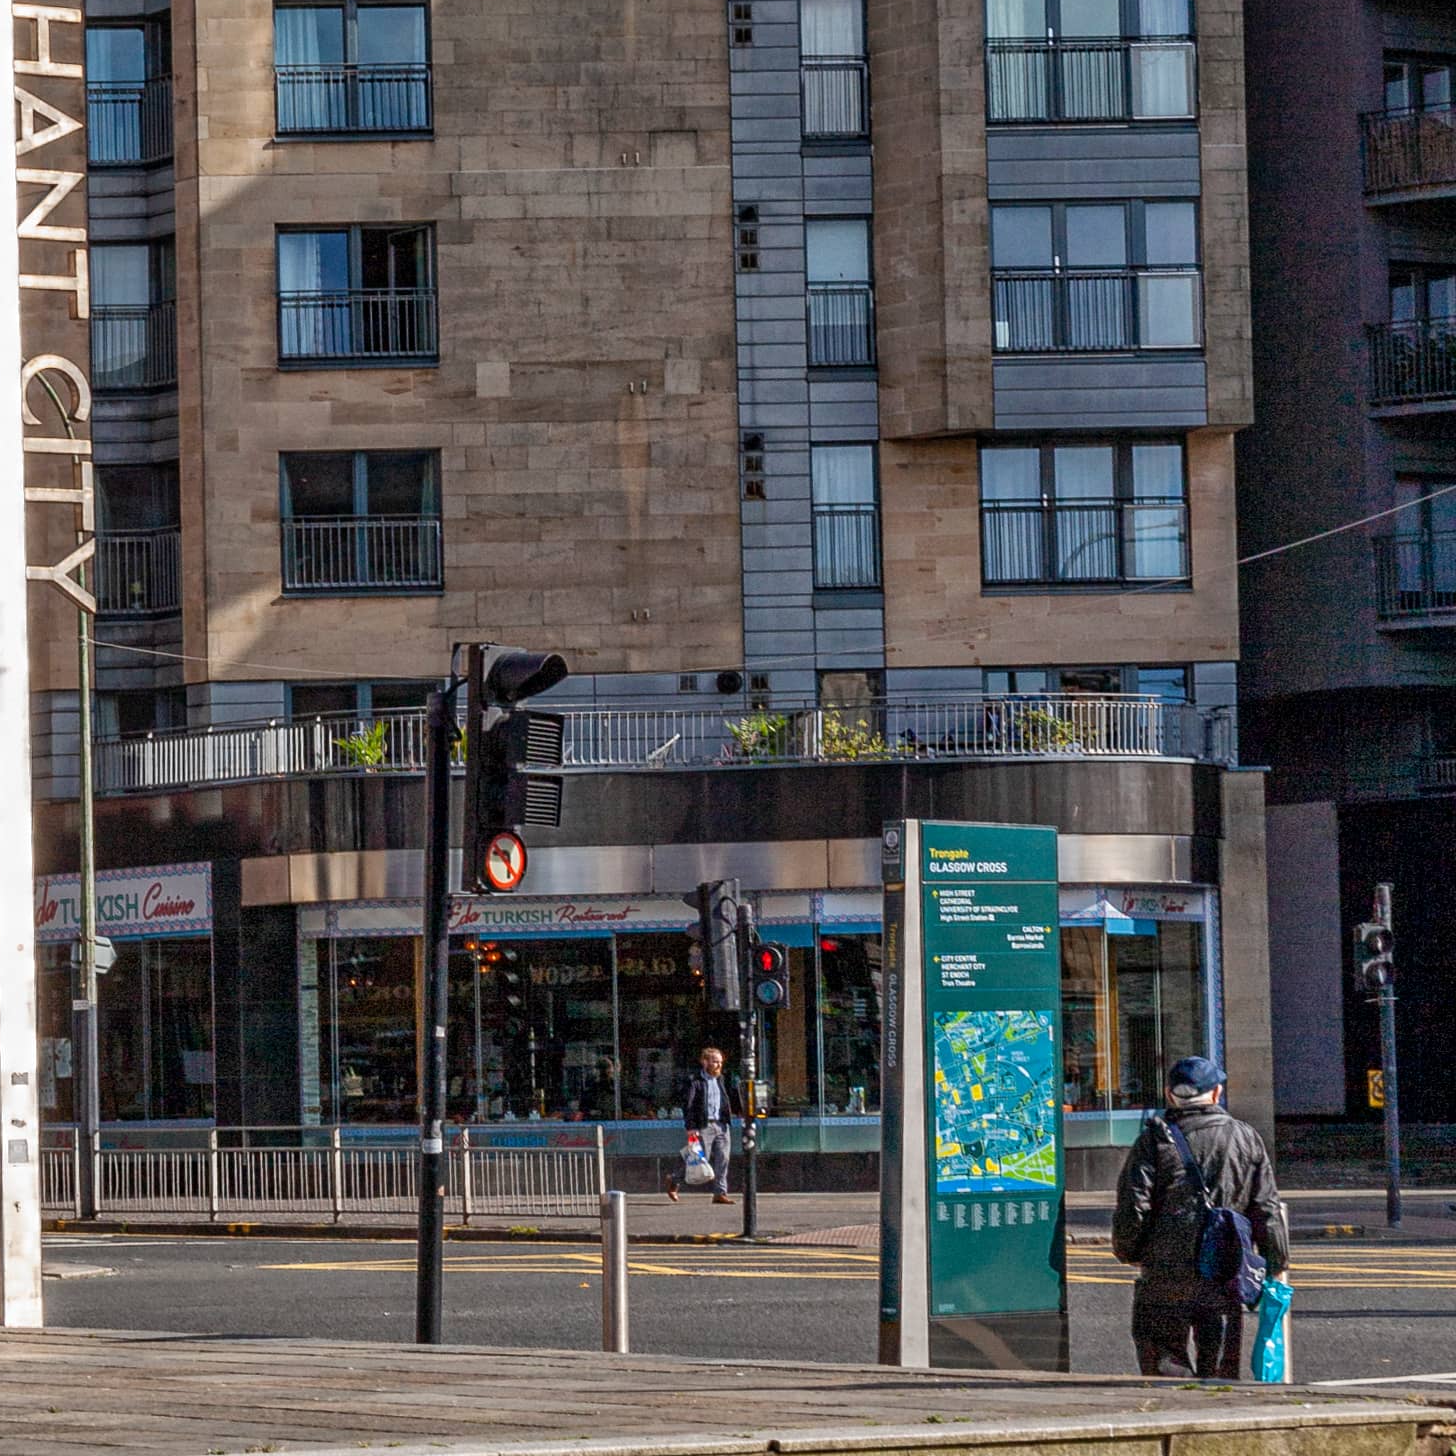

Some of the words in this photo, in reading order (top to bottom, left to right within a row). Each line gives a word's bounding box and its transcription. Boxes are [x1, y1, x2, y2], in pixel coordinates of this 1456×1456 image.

[22, 354, 96, 614] CITY
[929, 847, 970, 860] Trongate
[929, 862, 975, 873] GLASGOW
[976, 862, 1008, 873] CROSS
[35, 879, 59, 928] da
[60, 893, 139, 924] TUKISH
[143, 882, 196, 921] Cuisine
[482, 909, 553, 925] TURKISH
[888, 974, 897, 1028] GLASGOW
[887, 1030, 897, 1067] CROSS
